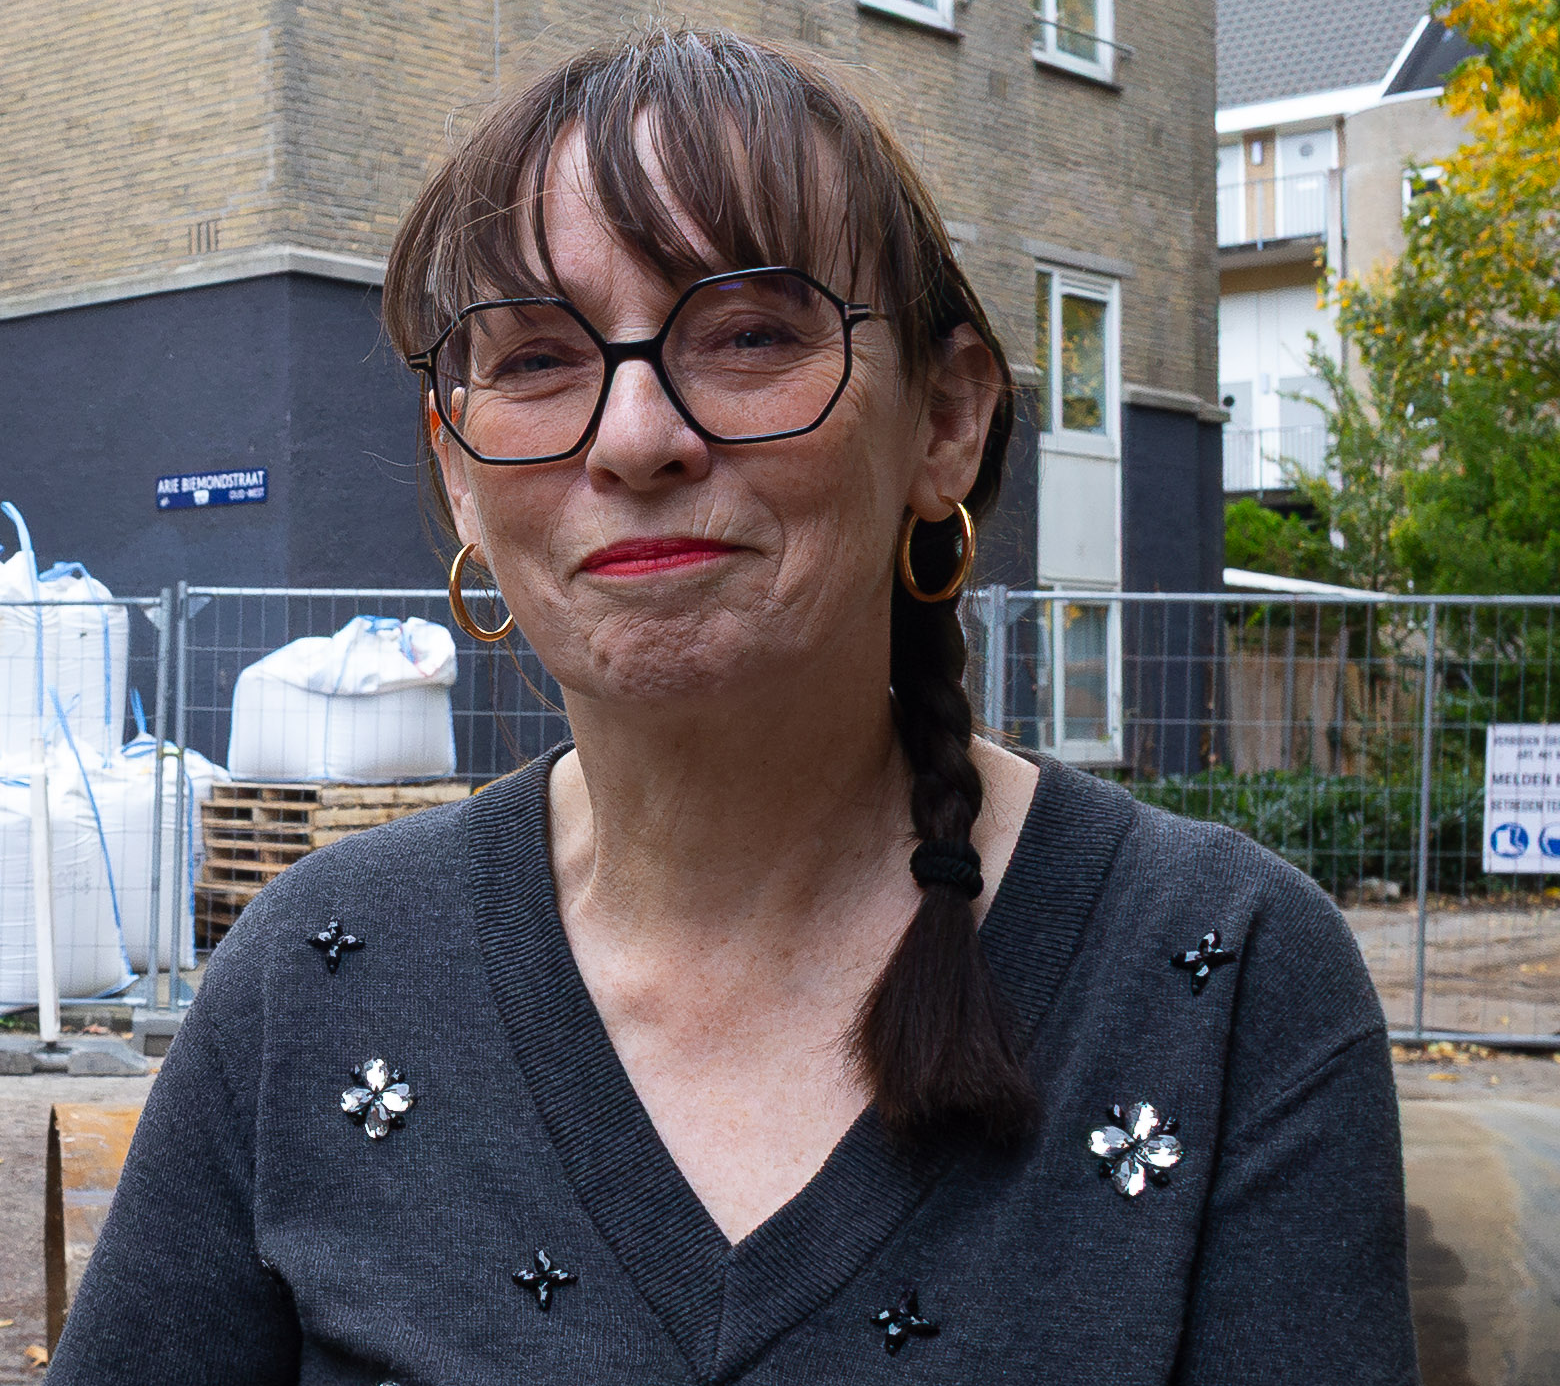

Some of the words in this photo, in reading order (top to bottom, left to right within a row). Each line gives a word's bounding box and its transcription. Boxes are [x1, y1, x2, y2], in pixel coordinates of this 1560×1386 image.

[157, 477, 180, 494] ARIE
[180, 471, 265, 492] BIEMONDSTRAAT
[1492, 773, 1551, 787] MELDEN
